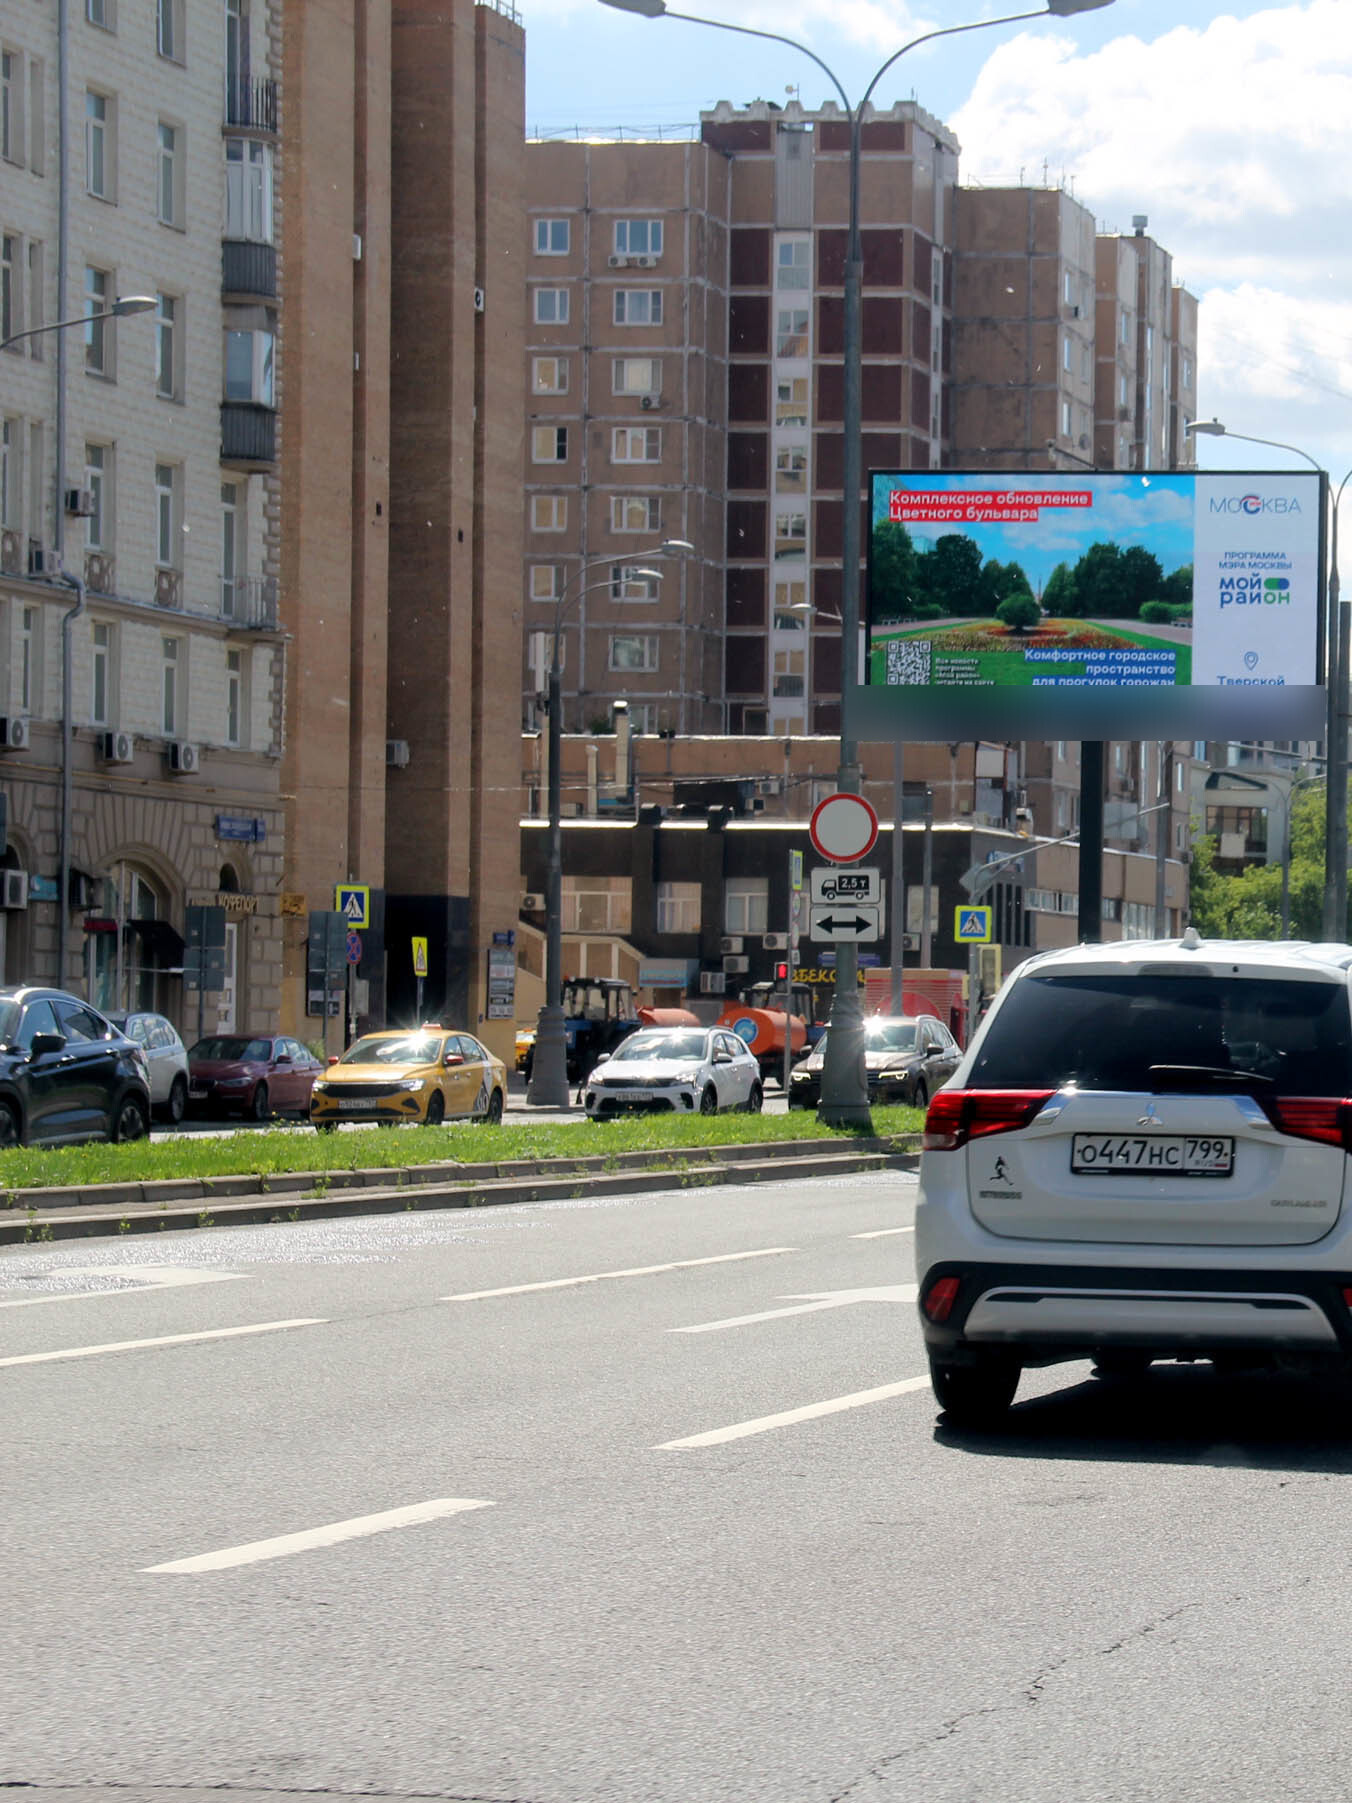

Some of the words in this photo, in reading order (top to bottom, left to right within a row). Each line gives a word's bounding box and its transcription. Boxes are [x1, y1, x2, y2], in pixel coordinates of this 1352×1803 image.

[890, 492, 993, 504] Комплексное
[996, 492, 1088, 504] обновление
[1209, 495, 1302, 514] МОСКВА
[890, 507, 963, 520] Цветного
[966, 506, 1038, 521] бульвара
[1224, 552, 1287, 560] ПРОГРАММА
[1219, 561, 1247, 569] МЭРА
[1249, 561, 1292, 569] МОСКВЫ
[1025, 650, 1106, 662] Комфортное
[1109, 652, 1175, 662] городское
[1086, 665, 1176, 675] пространство
[1217, 675, 1285, 685] Тверской
[841, 878, 858, 889] 2,5
[1187, 1140, 1225, 1159] 799
